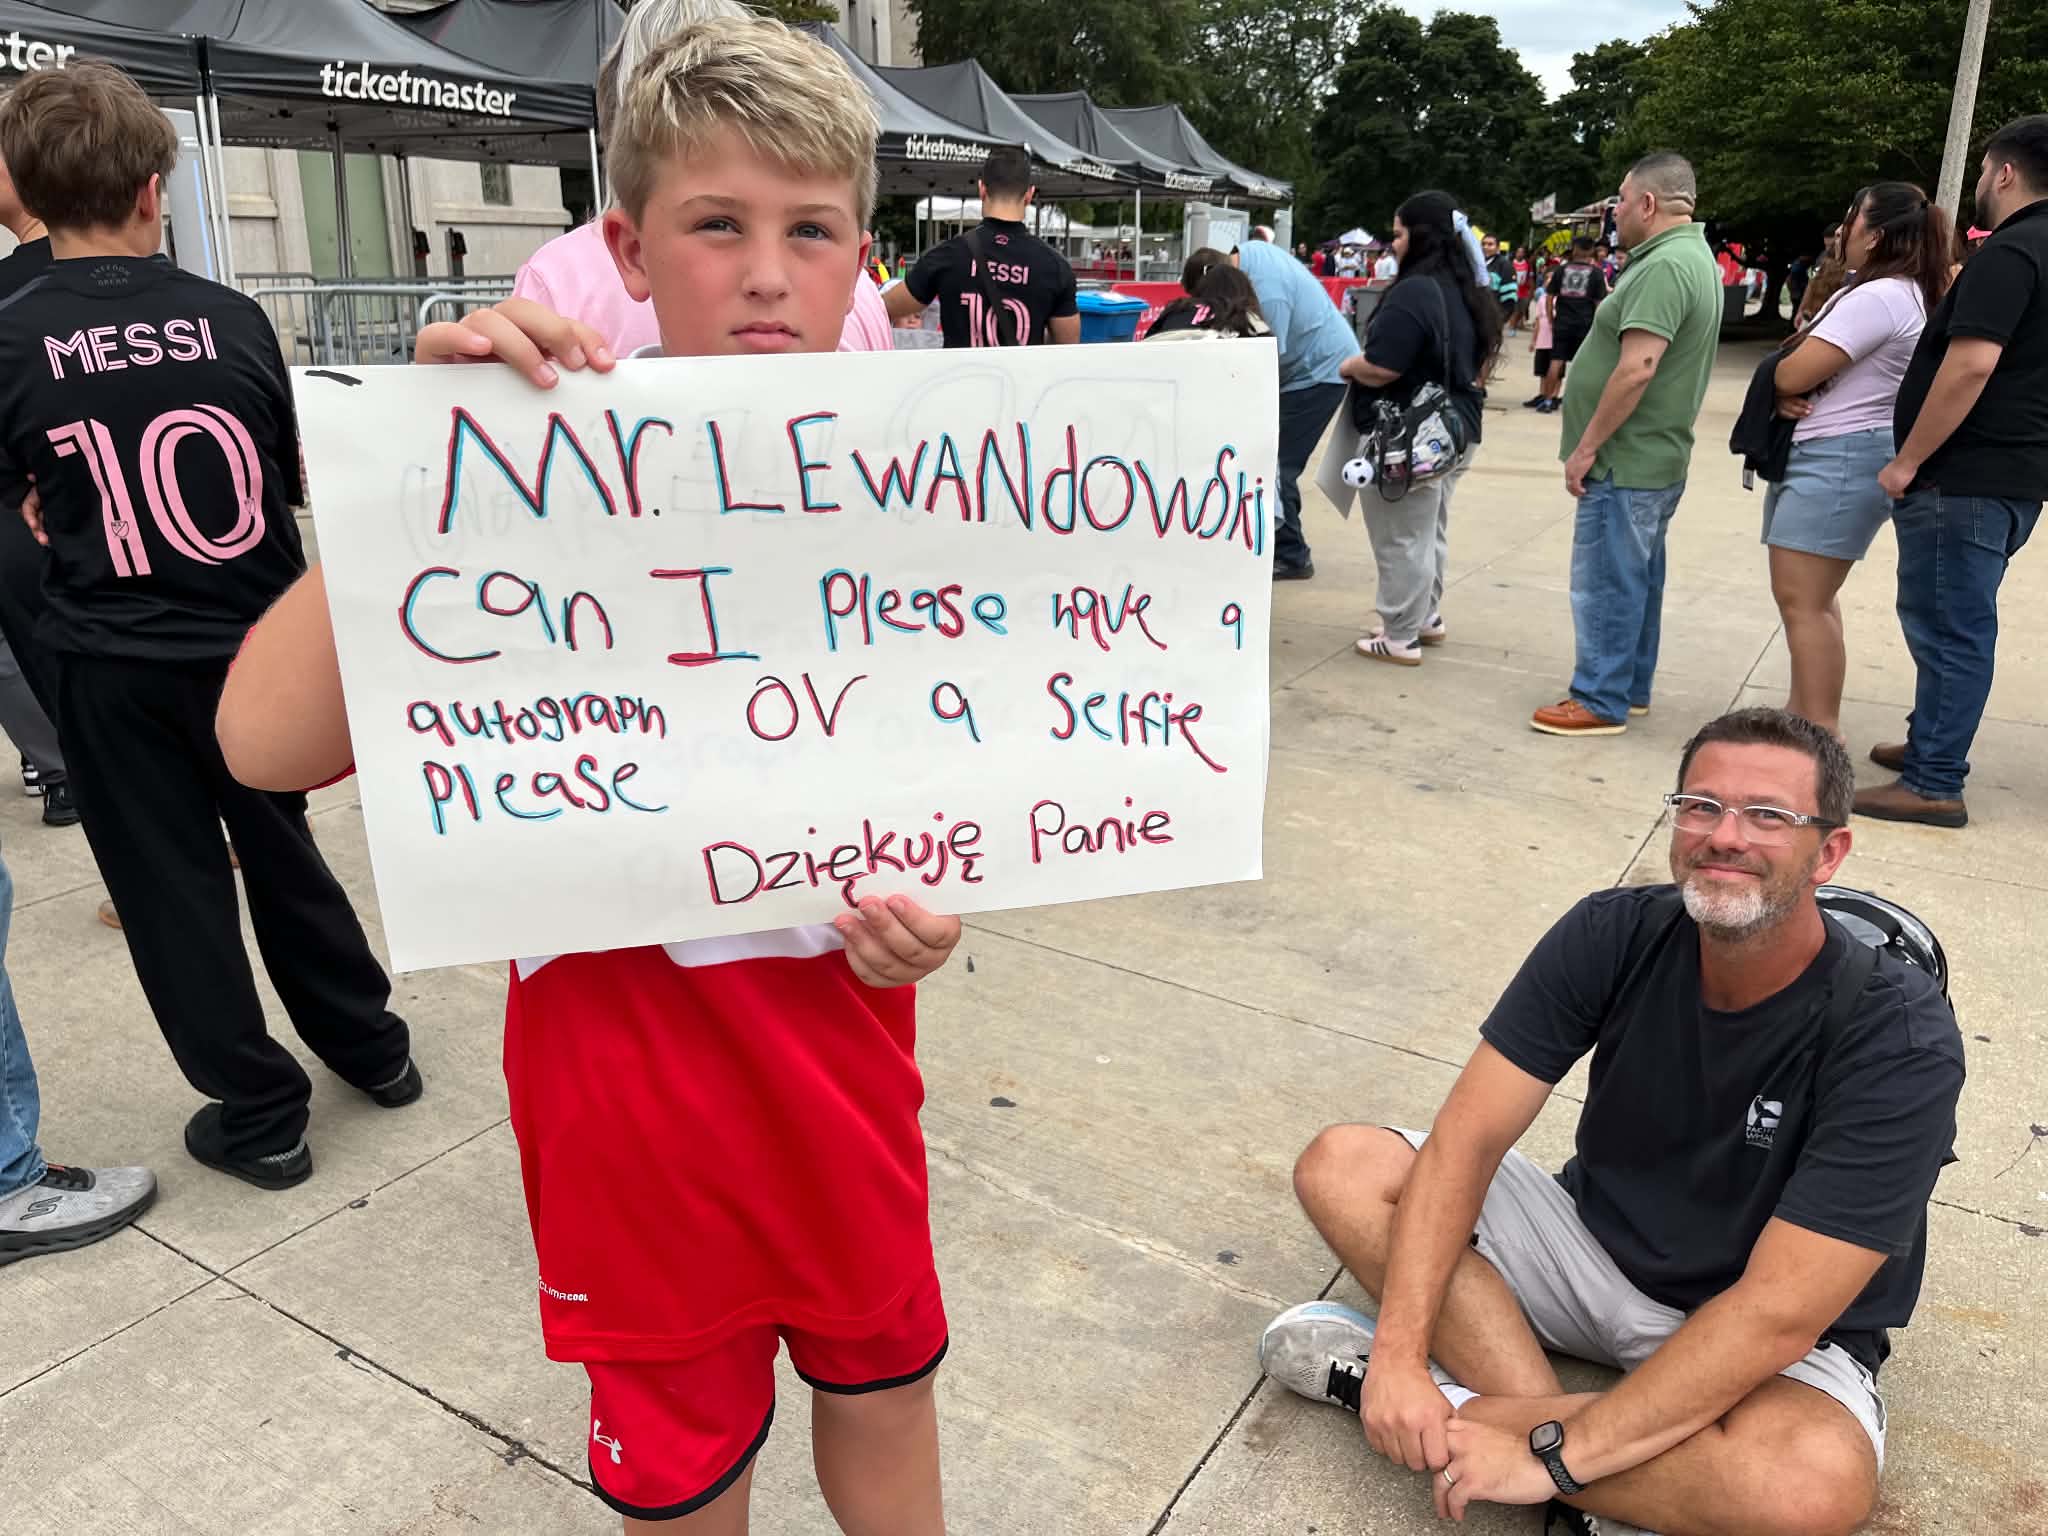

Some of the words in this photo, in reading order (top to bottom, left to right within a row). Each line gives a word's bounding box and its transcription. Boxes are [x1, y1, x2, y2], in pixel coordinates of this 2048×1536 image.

[0, 31, 76, 72] ter
[319, 60, 517, 117] ticketmaster
[970, 258, 1030, 286] ESSI
[43, 317, 218, 380] MESSI
[960, 292, 1031, 348] 10
[46, 403, 266, 578] 10
[438, 406, 675, 535] Mr.
[650, 566, 761, 667] I
[1052, 583, 1168, 652] have
[1221, 602, 1245, 651] a
[406, 691, 668, 747] autograph
[930, 679, 983, 743] a
[702, 811, 985, 908] Dziękuję
[1029, 796, 1176, 864] Panie
